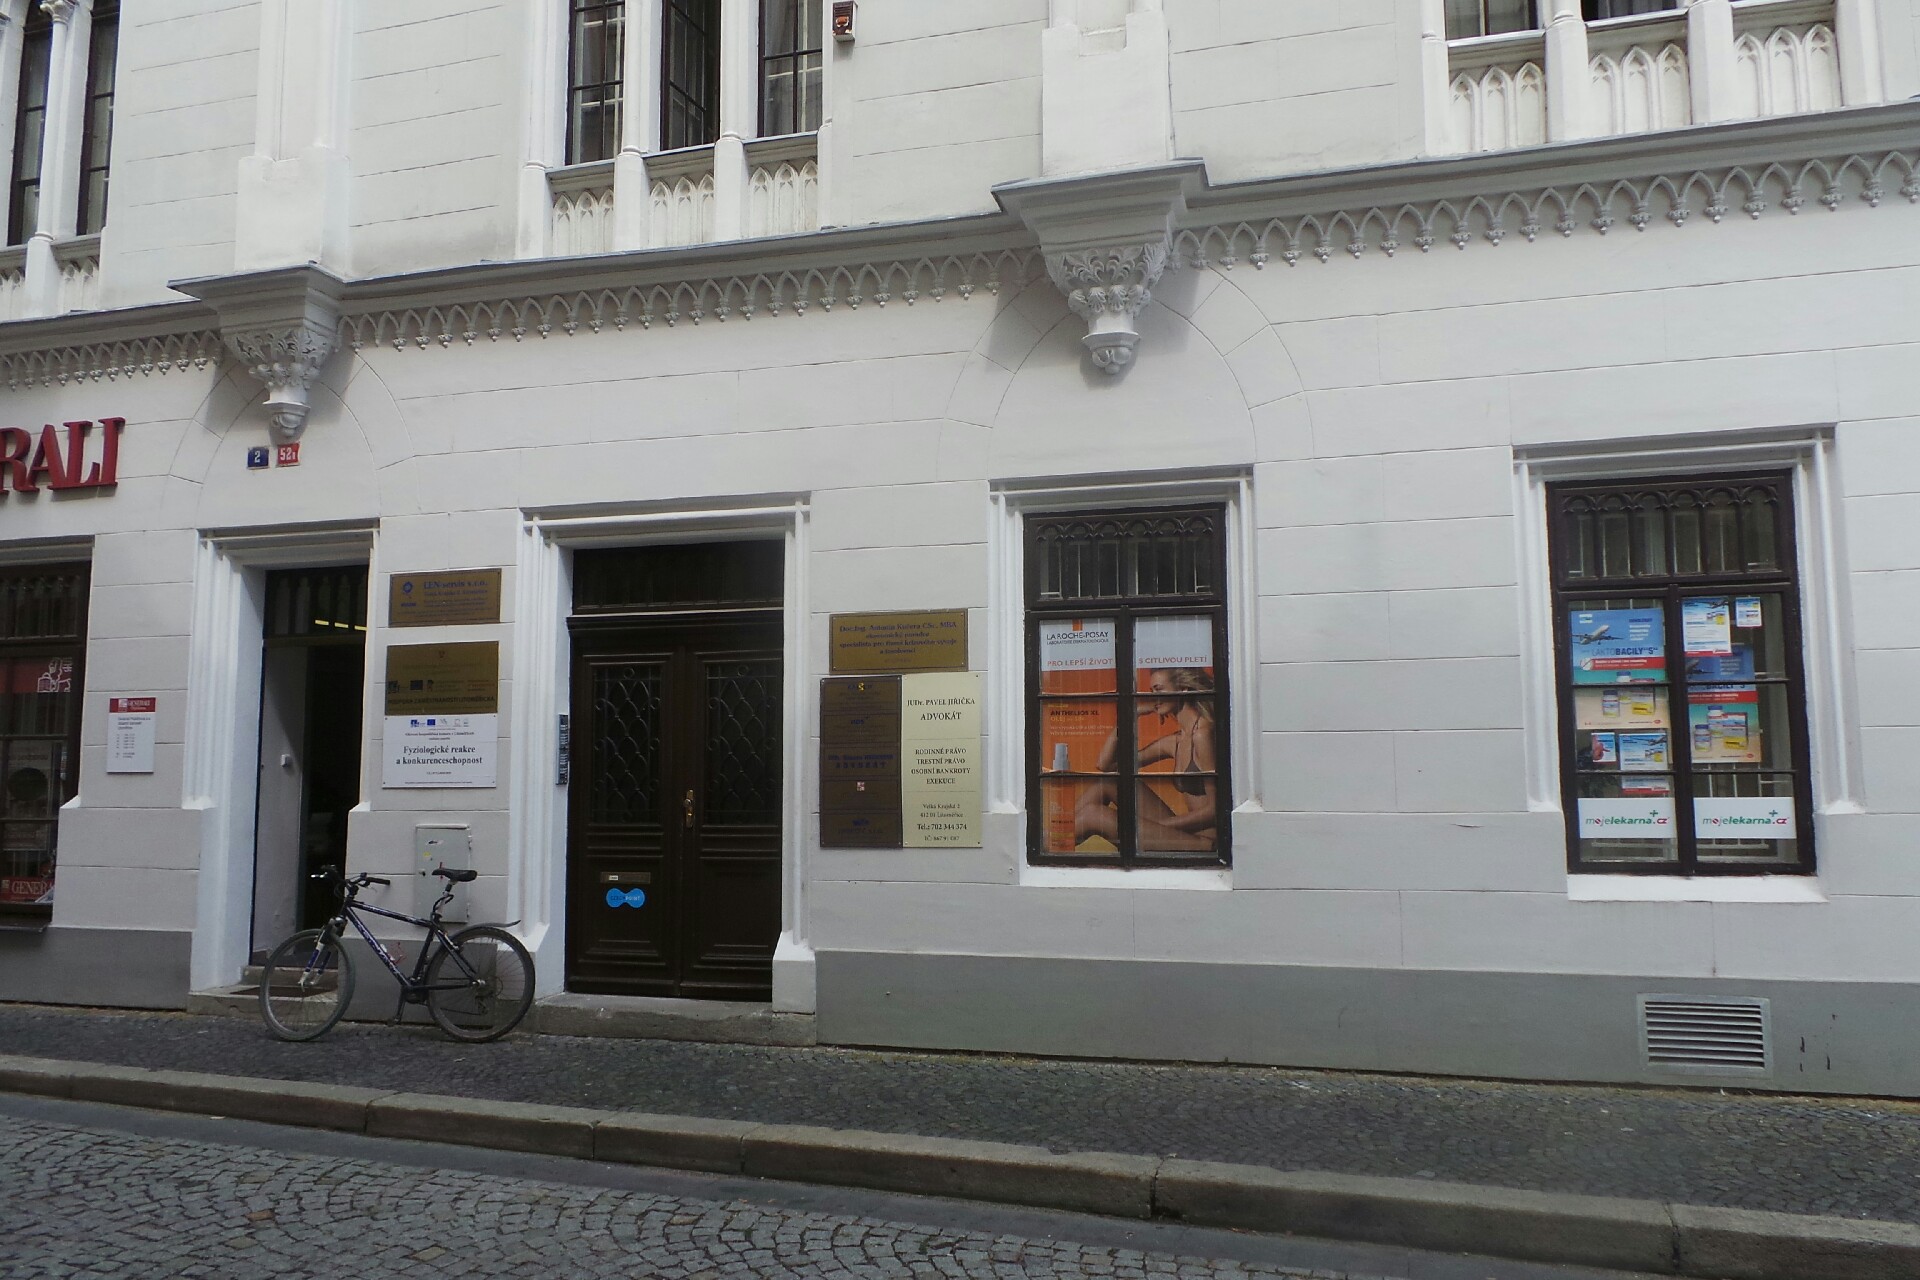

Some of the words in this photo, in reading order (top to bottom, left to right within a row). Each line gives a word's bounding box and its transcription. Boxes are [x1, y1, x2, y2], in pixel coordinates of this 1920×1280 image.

[0, 416, 125, 495] RALI
[254, 450, 261, 463] 2
[1065, 657, 1087, 666] LEPŠÍ
[1089, 657, 1113, 666] ŽIVOT
[1184, 655, 1207, 663] PLETÍ
[907, 699, 925, 707] JUDr.
[925, 698, 946, 706] PAVEL
[948, 696, 975, 706] JIŘIČKA
[920, 710, 962, 721] ADVOKÁT
[403, 745, 449, 756] Fyziologické
[451, 745, 476, 753] reakce
[915, 747, 944, 755] RODINNÉ
[945, 746, 967, 755] PRÁVO
[402, 756, 483, 766] konkurenceschopnost
[916, 757, 943, 765] TRESTNÍ
[911, 767, 935, 775] OSOBNÍ
[936, 767, 971, 775] BANKROTY
[926, 777, 956, 785] EXEKUCE
[1585, 816, 1668, 827] mojelekarna.cz
[1702, 815, 1788, 827] mojelekarna.cz
